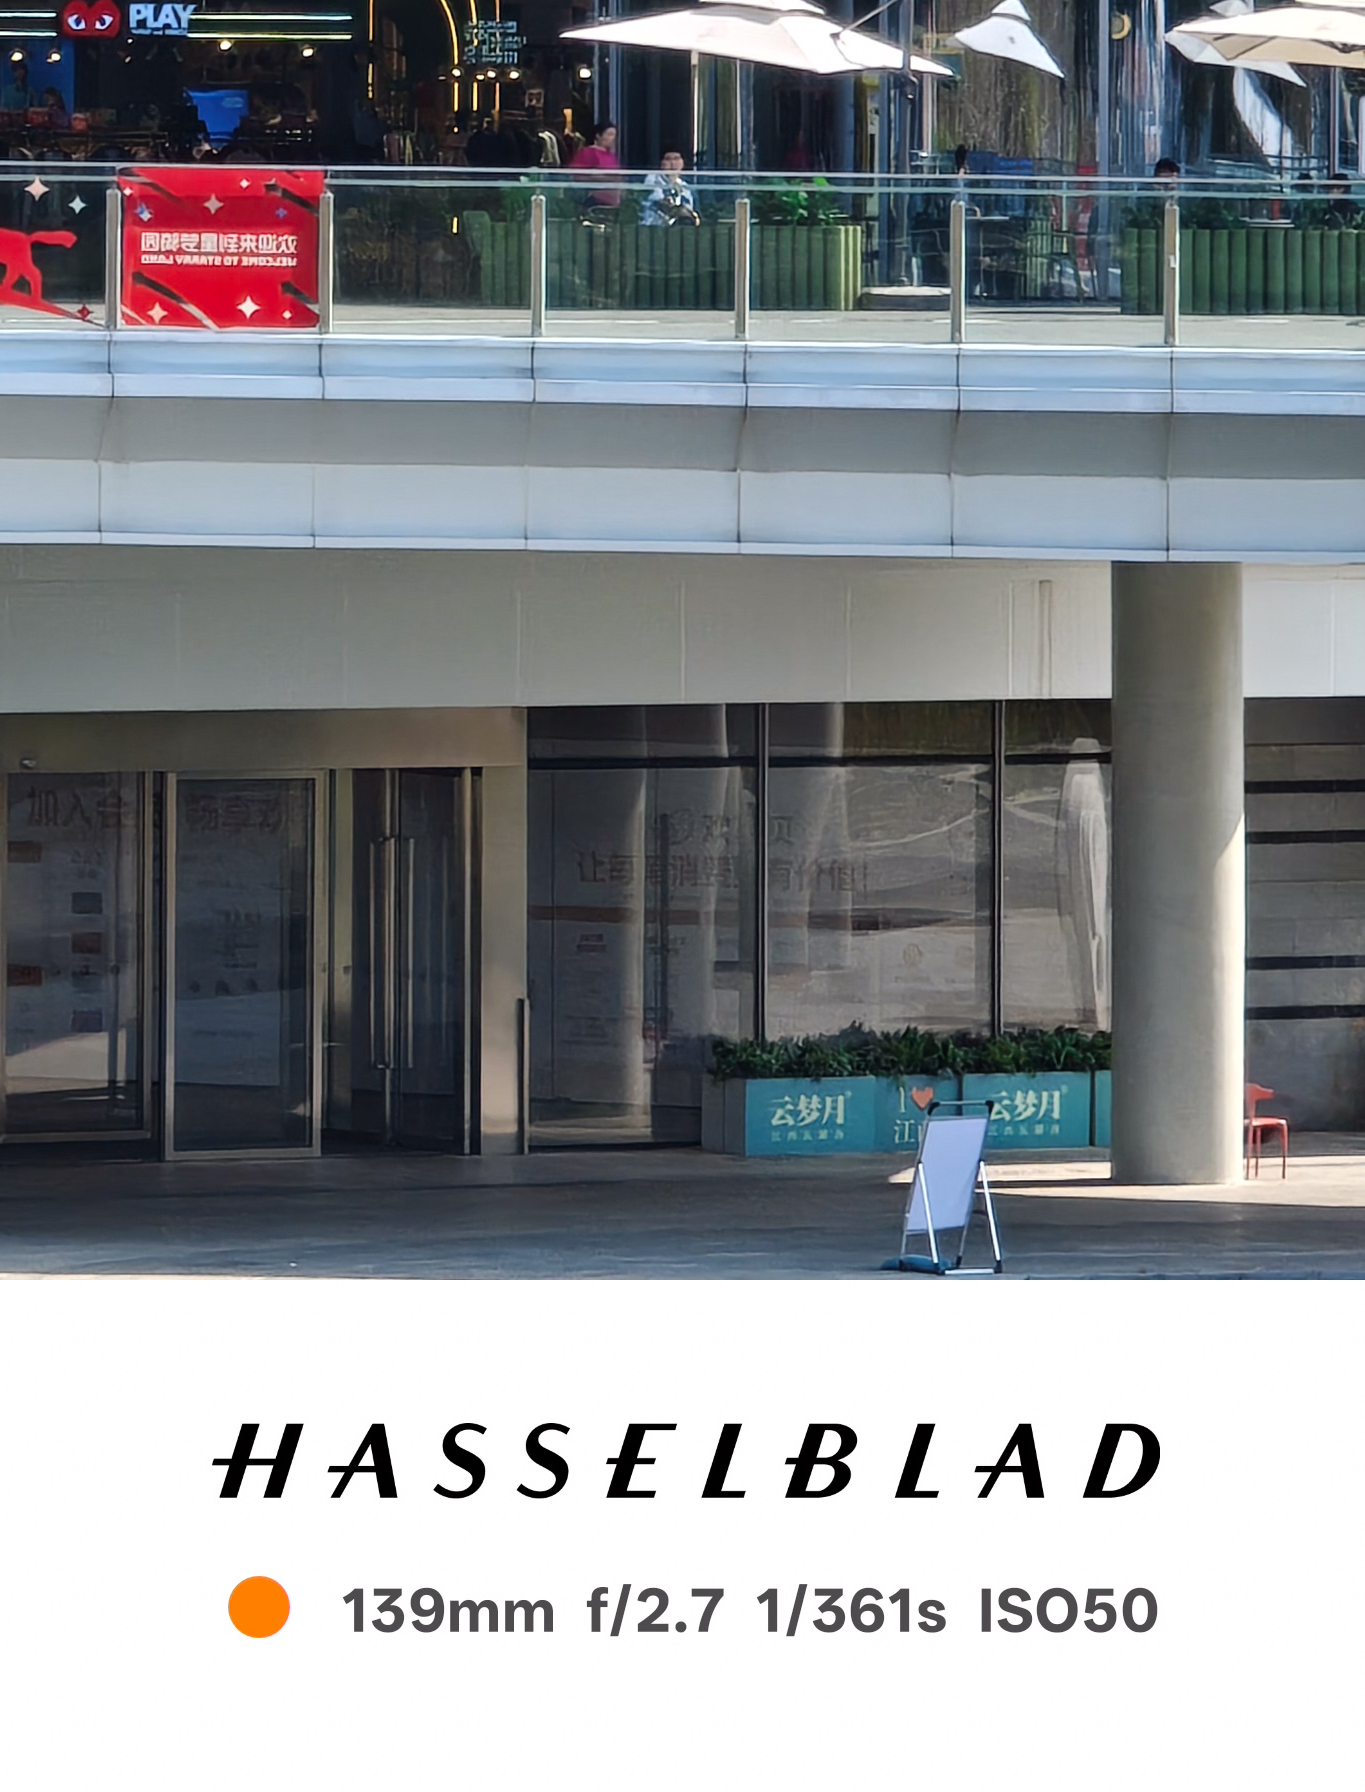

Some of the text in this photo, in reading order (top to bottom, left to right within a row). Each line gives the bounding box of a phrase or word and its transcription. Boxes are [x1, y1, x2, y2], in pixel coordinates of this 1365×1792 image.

[129, 3, 198, 30] PLAY
[769, 1094, 846, 1127] 云梦月
[893, 1118, 924, 1145] 江
